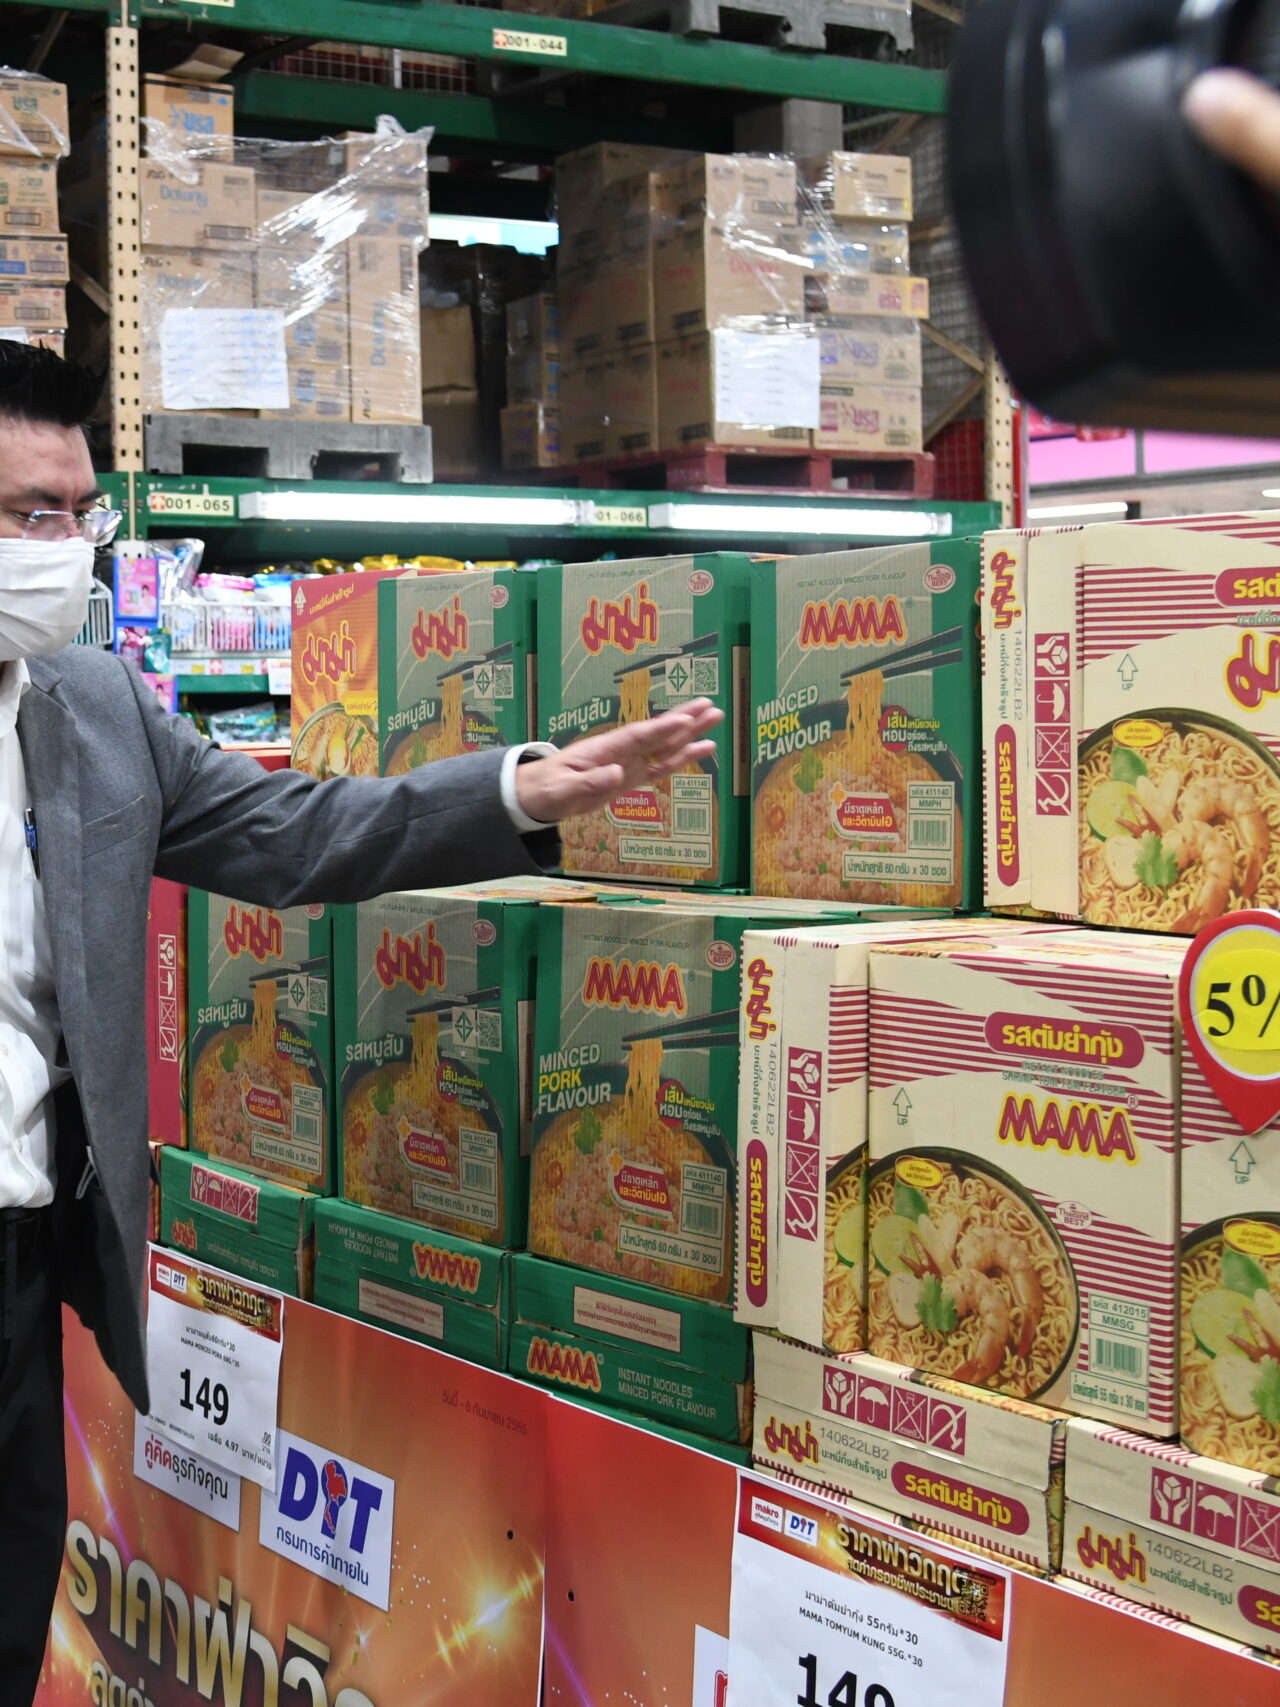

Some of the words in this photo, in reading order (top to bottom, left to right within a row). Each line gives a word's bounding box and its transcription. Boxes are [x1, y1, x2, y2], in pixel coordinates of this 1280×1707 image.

[160, 184, 208, 208] Downy
[165, 497, 230, 512] 001-065
[594, 511, 643, 522] 01-066
[990, 550, 1022, 630] มาม่า
[411, 594, 468, 661] มาม่า
[582, 581, 659, 655] มาม่า
[799, 597, 906, 649] MAMA
[301, 620, 356, 685] มาม่า
[1014, 629, 1023, 721] 140622LB2
[1122, 683, 1134, 691] UP
[387, 699, 436, 732] รสหมูสับ
[548, 697, 611, 732] รสหมูสับ
[757, 685, 818, 724] MINCED
[757, 713, 801, 744] PORK
[757, 720, 832, 764] FLAVOUR
[681, 790, 702, 798] MMPH
[844, 802, 884, 816] มีธาตุเหล็ก
[918, 799, 942, 808] MMPH
[655, 844, 663, 857] 60
[684, 848, 692, 858] 30
[884, 862, 894, 875] 60
[919, 864, 929, 875] 30
[375, 921, 447, 995] มาม่า
[585, 958, 687, 1016] MAMA
[747, 957, 777, 1041] มาม่า
[198, 999, 247, 1028] รสหมูสับ
[346, 1034, 404, 1066] รสหมูสับ
[539, 1044, 601, 1074] MINCED
[1002, 1023, 1124, 1065] รสต้มยำกุ้ง
[538, 1070, 582, 1095] PORK
[1002, 1071, 1035, 1083] SHRIMP
[1083, 1083, 1128, 1097] FLAVOUR
[1021, 1060, 1060, 1075] INSTANT
[1061, 1066, 1105, 1081] NOODLES
[538, 1083, 612, 1115] FLAVOUR
[766, 1042, 778, 1137] 140622LB2
[897, 1117, 908, 1126] UP
[997, 1093, 1138, 1163] MAMA
[621, 1170, 659, 1188] มีธาตุเหล็ก
[691, 1181, 715, 1194] MMPH
[1234, 1175, 1250, 1185] UP
[1058, 1207, 1090, 1221] Thailand
[1063, 1217, 1084, 1227] BEST
[328, 1222, 358, 1238] FLAVOUR
[357, 1232, 374, 1245] PORK
[375, 1236, 399, 1251] MINCED
[344, 1239, 372, 1254] NOODLES
[372, 1247, 399, 1264] INSTANT
[658, 1241, 668, 1253] 60
[691, 1248, 700, 1261] 30
[413, 1242, 481, 1293] MAMA
[1102, 1314, 1135, 1331] MMSG
[1111, 1302, 1147, 1319] 412015
[180, 1336, 195, 1348] MAMA
[195, 1341, 212, 1355] MINCED
[212, 1349, 223, 1361] PORK
[527, 1336, 601, 1392] MAMA
[180, 1368, 229, 1426] 149
[618, 1367, 651, 1387] INSTANT
[653, 1376, 693, 1398] NOODLES
[618, 1382, 649, 1400] MINCED
[651, 1390, 674, 1408] PORK
[676, 1398, 716, 1420] FLAVOUR
[225, 1439, 239, 1453] 4.97
[763, 1416, 819, 1463] มาม่า
[820, 1427, 890, 1461] 140622LB2
[144, 1433, 228, 1501] คู่คิดธุรกิจคุณ
[821, 1448, 887, 1480] บะหมี่กึ่งสำเร็จรูป
[278, 1446, 383, 1555] DIT
[754, 1503, 780, 1519] makro
[905, 1473, 1012, 1529] รสต้มยำกุ้ง
[789, 1514, 816, 1536] DIT
[276, 1526, 370, 1587] กรมการค้าภายใน
[1076, 1525, 1148, 1584] มาม่า
[1146, 1540, 1234, 1583] 140622LB2
[1149, 1567, 1233, 1606] บะหมี่กึ่งสำเร็จรูป
[804, 1590, 864, 1624] มาม่าต้มยำกุ้ง
[798, 1606, 823, 1625] MAMA
[825, 1617, 860, 1642] TOMYUM
[861, 1633, 886, 1653] KUNG
